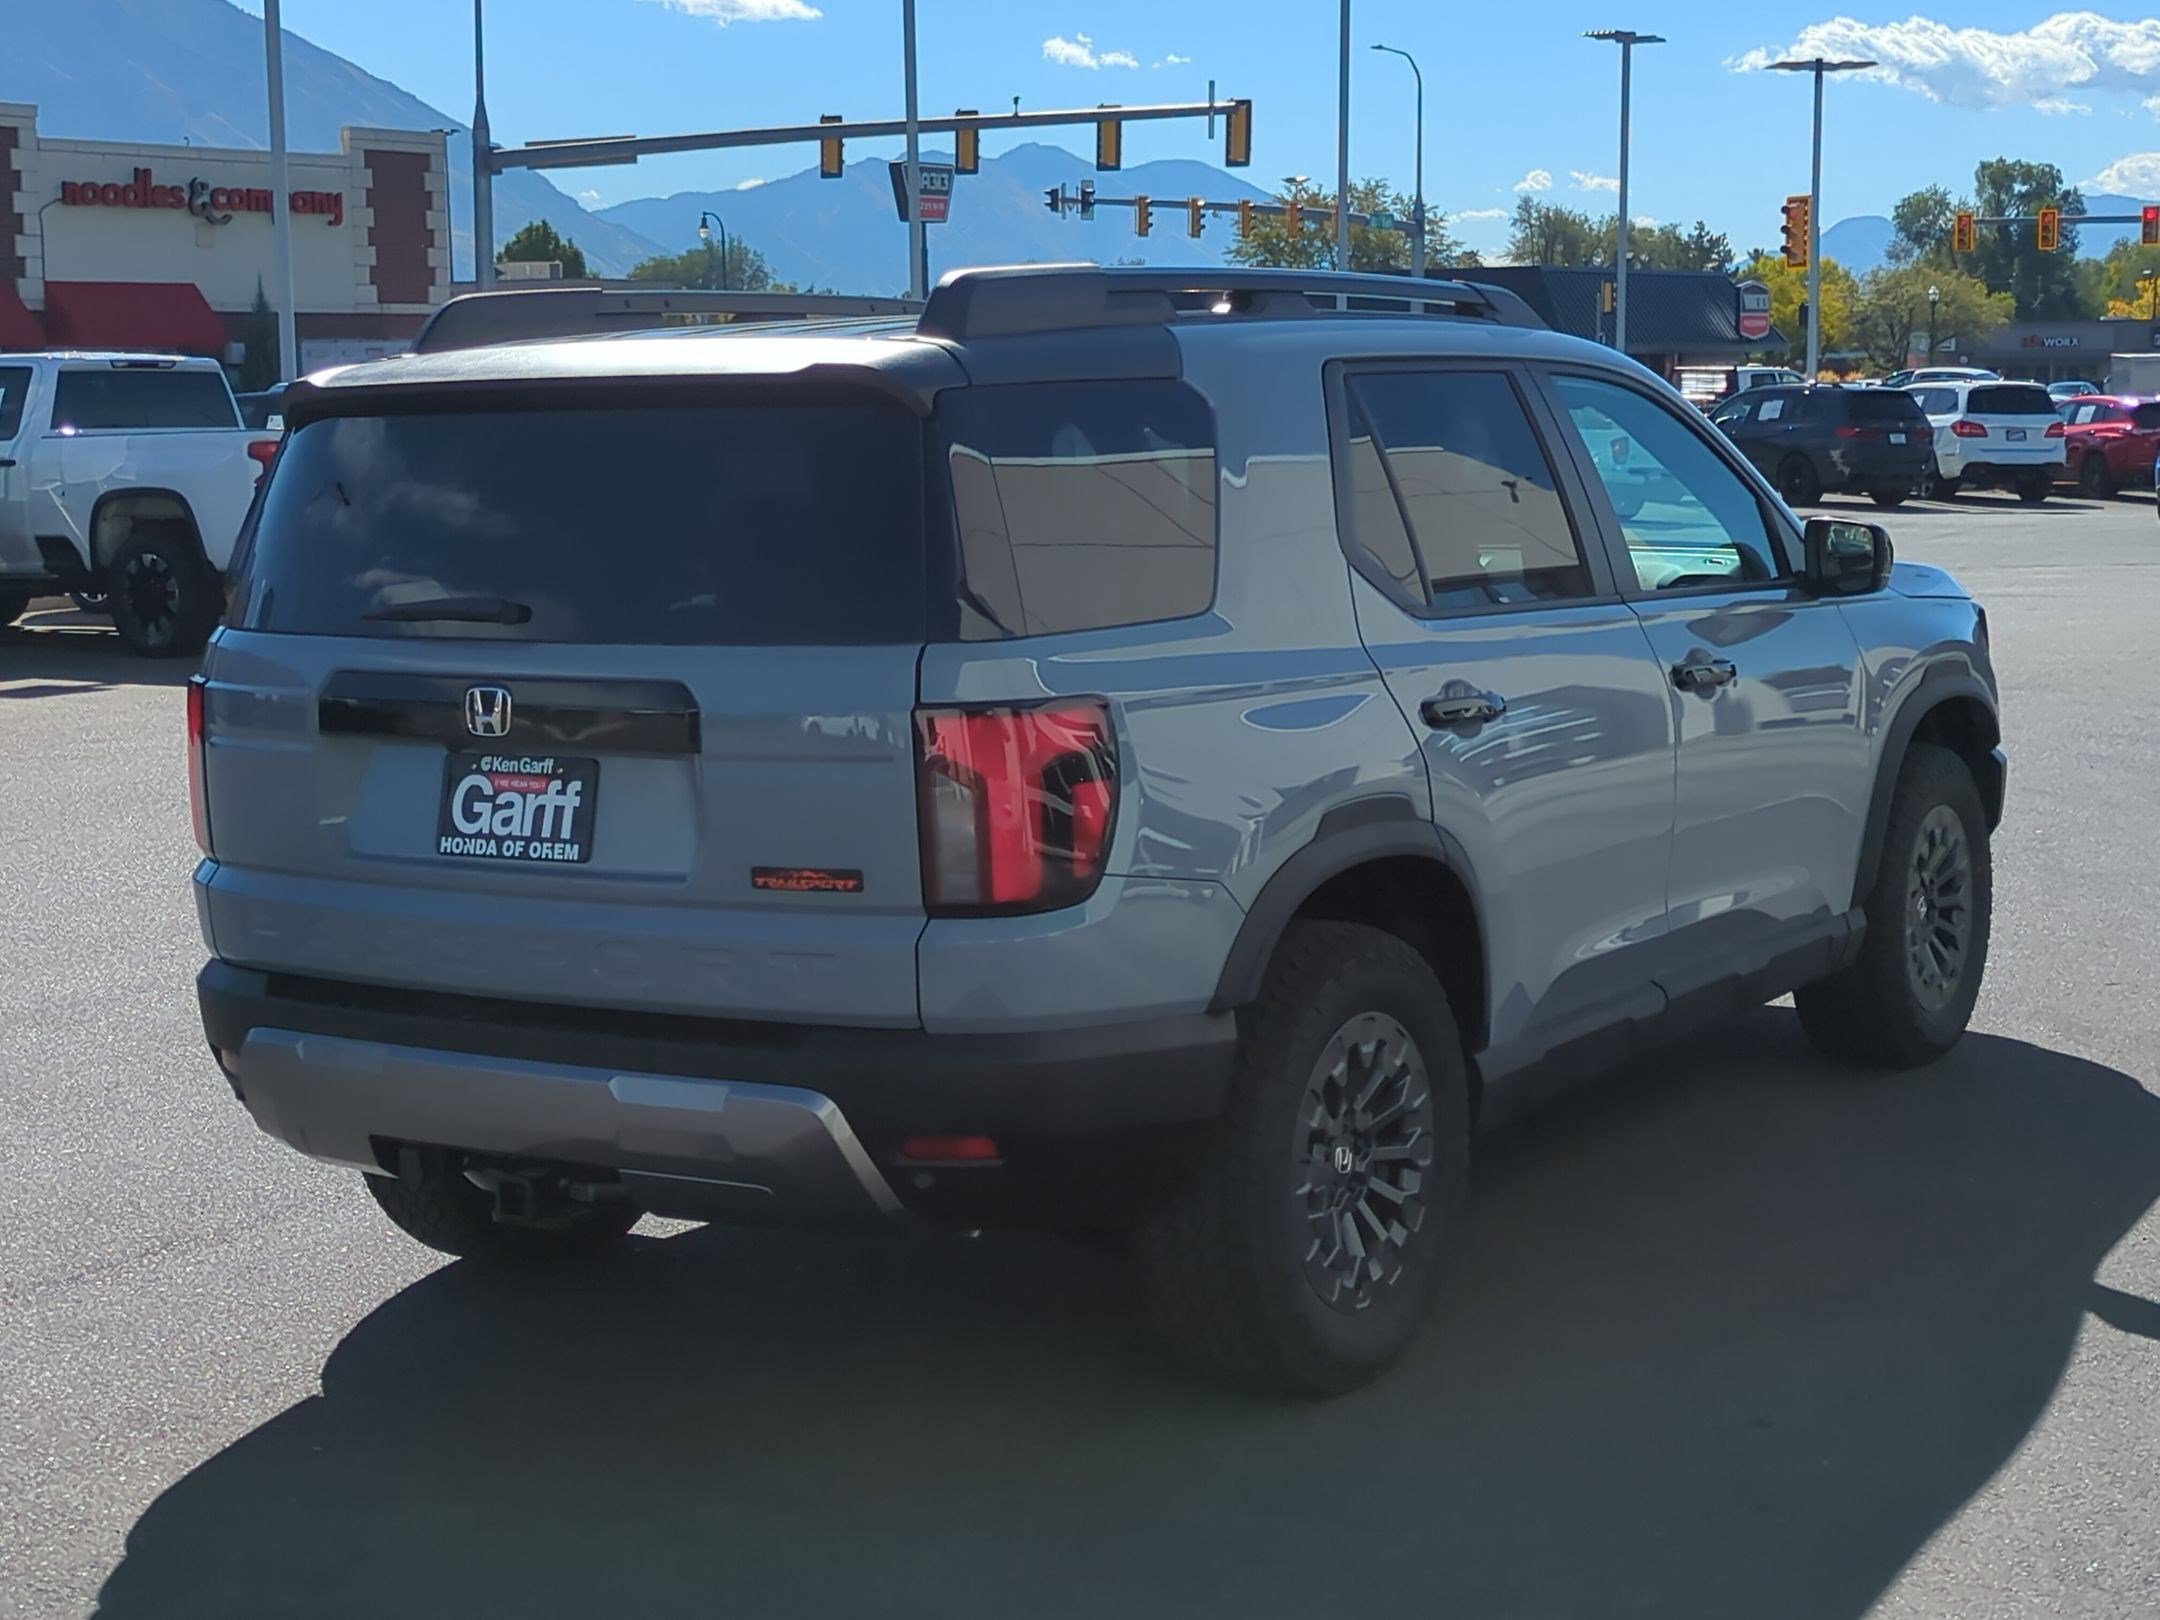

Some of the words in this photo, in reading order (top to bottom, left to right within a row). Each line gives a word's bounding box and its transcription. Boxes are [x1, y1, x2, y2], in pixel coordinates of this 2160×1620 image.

[61, 167, 186, 209] noodles
[492, 756, 518, 772] Ken
[519, 757, 555, 774] Garff
[451, 774, 583, 840] Garff
[440, 836, 498, 856] HONDA
[502, 840, 526, 857] OF
[529, 842, 580, 860] OREM
